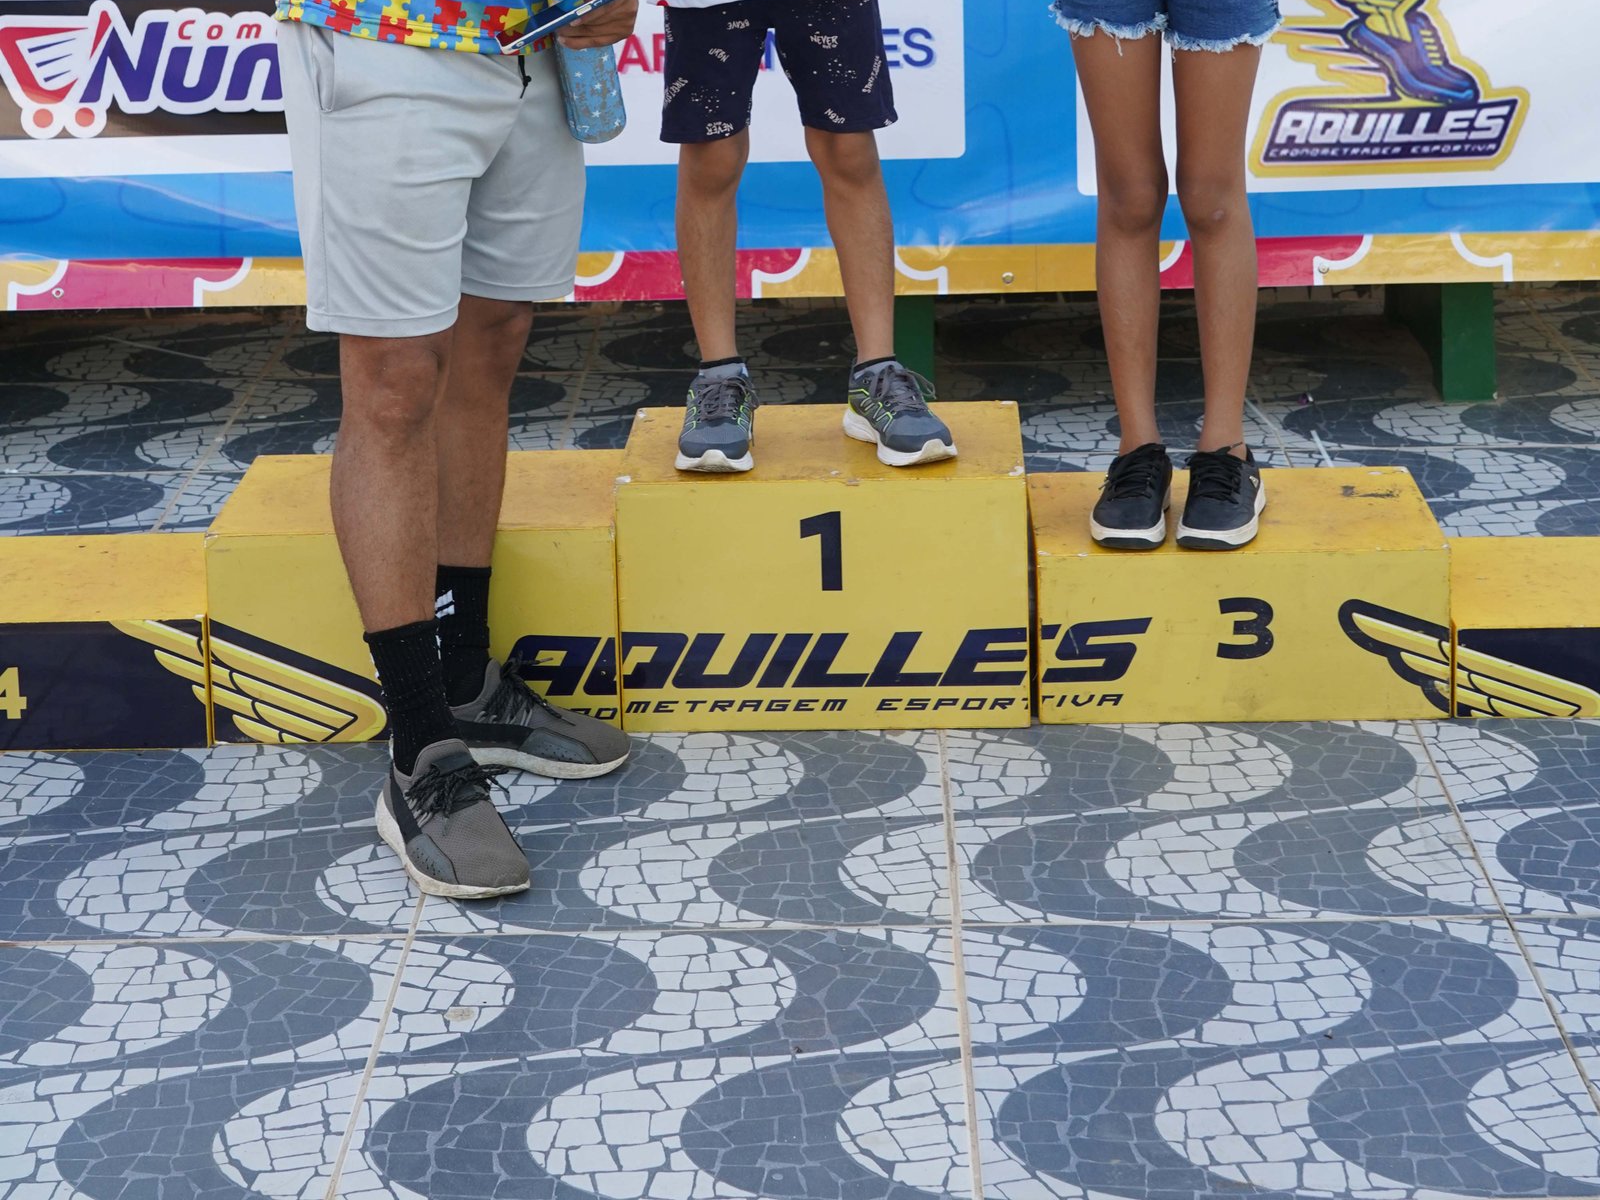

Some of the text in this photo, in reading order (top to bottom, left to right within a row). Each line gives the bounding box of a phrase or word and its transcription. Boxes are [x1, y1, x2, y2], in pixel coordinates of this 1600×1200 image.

[178, 19, 265, 41] Com
[79, 21, 283, 103] Nun
[1275, 106, 1510, 144] AQUILLES
[800, 511, 843, 591] 1
[503, 617, 1153, 696] AQUILLES
[1216, 597, 1274, 660] 3
[876, 693, 1125, 712] ESPORTIVA
